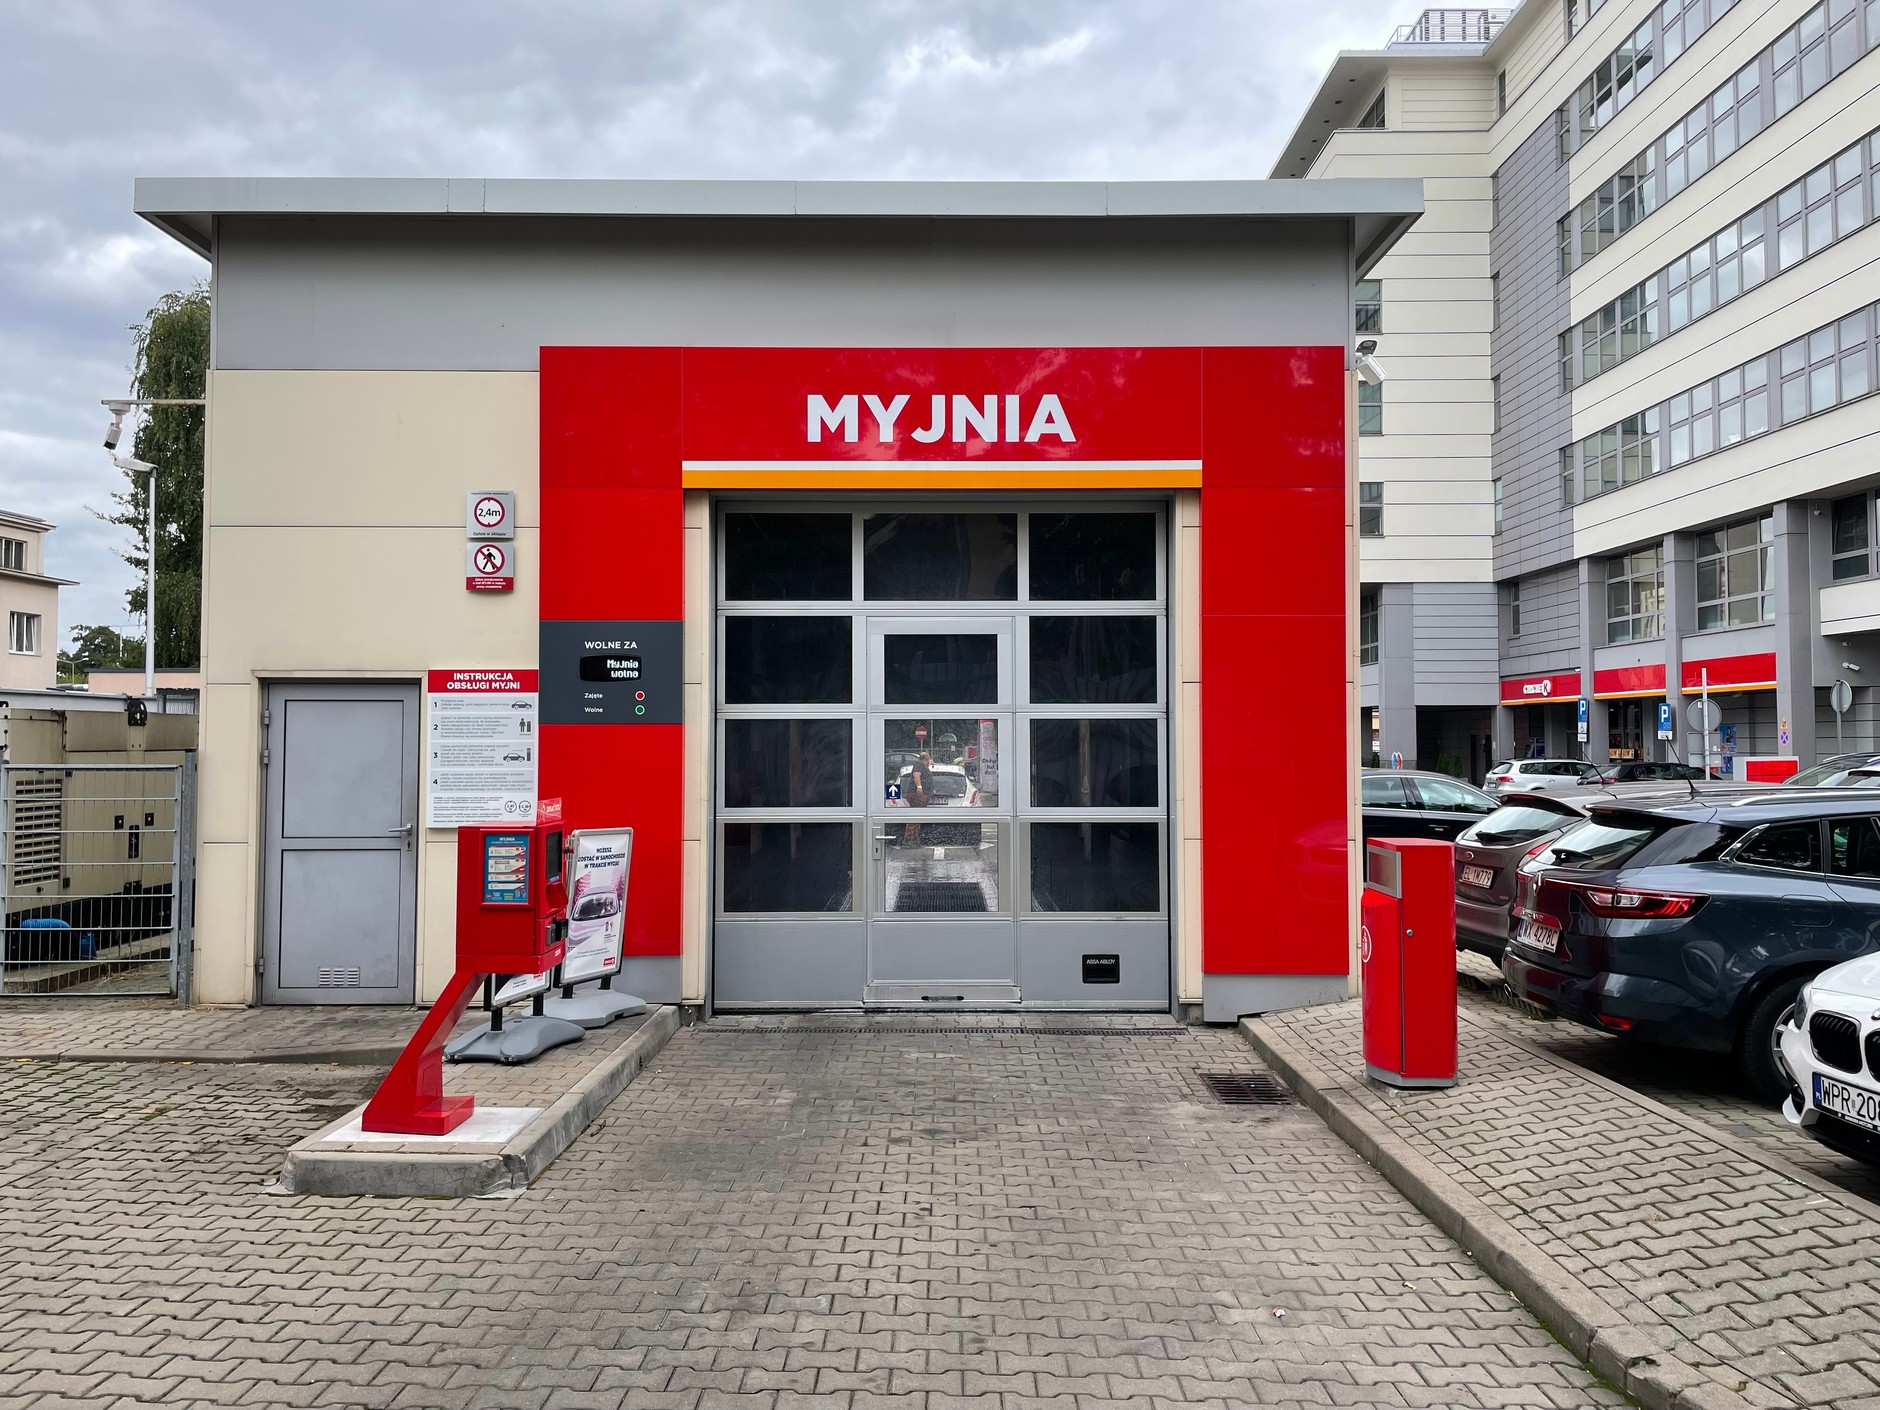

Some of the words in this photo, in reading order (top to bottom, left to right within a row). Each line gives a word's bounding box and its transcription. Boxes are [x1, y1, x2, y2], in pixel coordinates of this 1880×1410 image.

[806, 394, 1077, 443] MYJNIA
[478, 508, 501, 518] 2,4m
[585, 641, 621, 649] WOLNE
[453, 672, 513, 681] INSTRUKCJA
[611, 670, 639, 678] wolna
[446, 681, 490, 690] OBSŁUGI
[492, 681, 521, 690] MYJNI
[1580, 700, 1586, 715] P
[1661, 706, 1668, 722] P
[1534, 926, 1556, 946] 4278C
[1822, 1079, 1850, 1113] WPR
